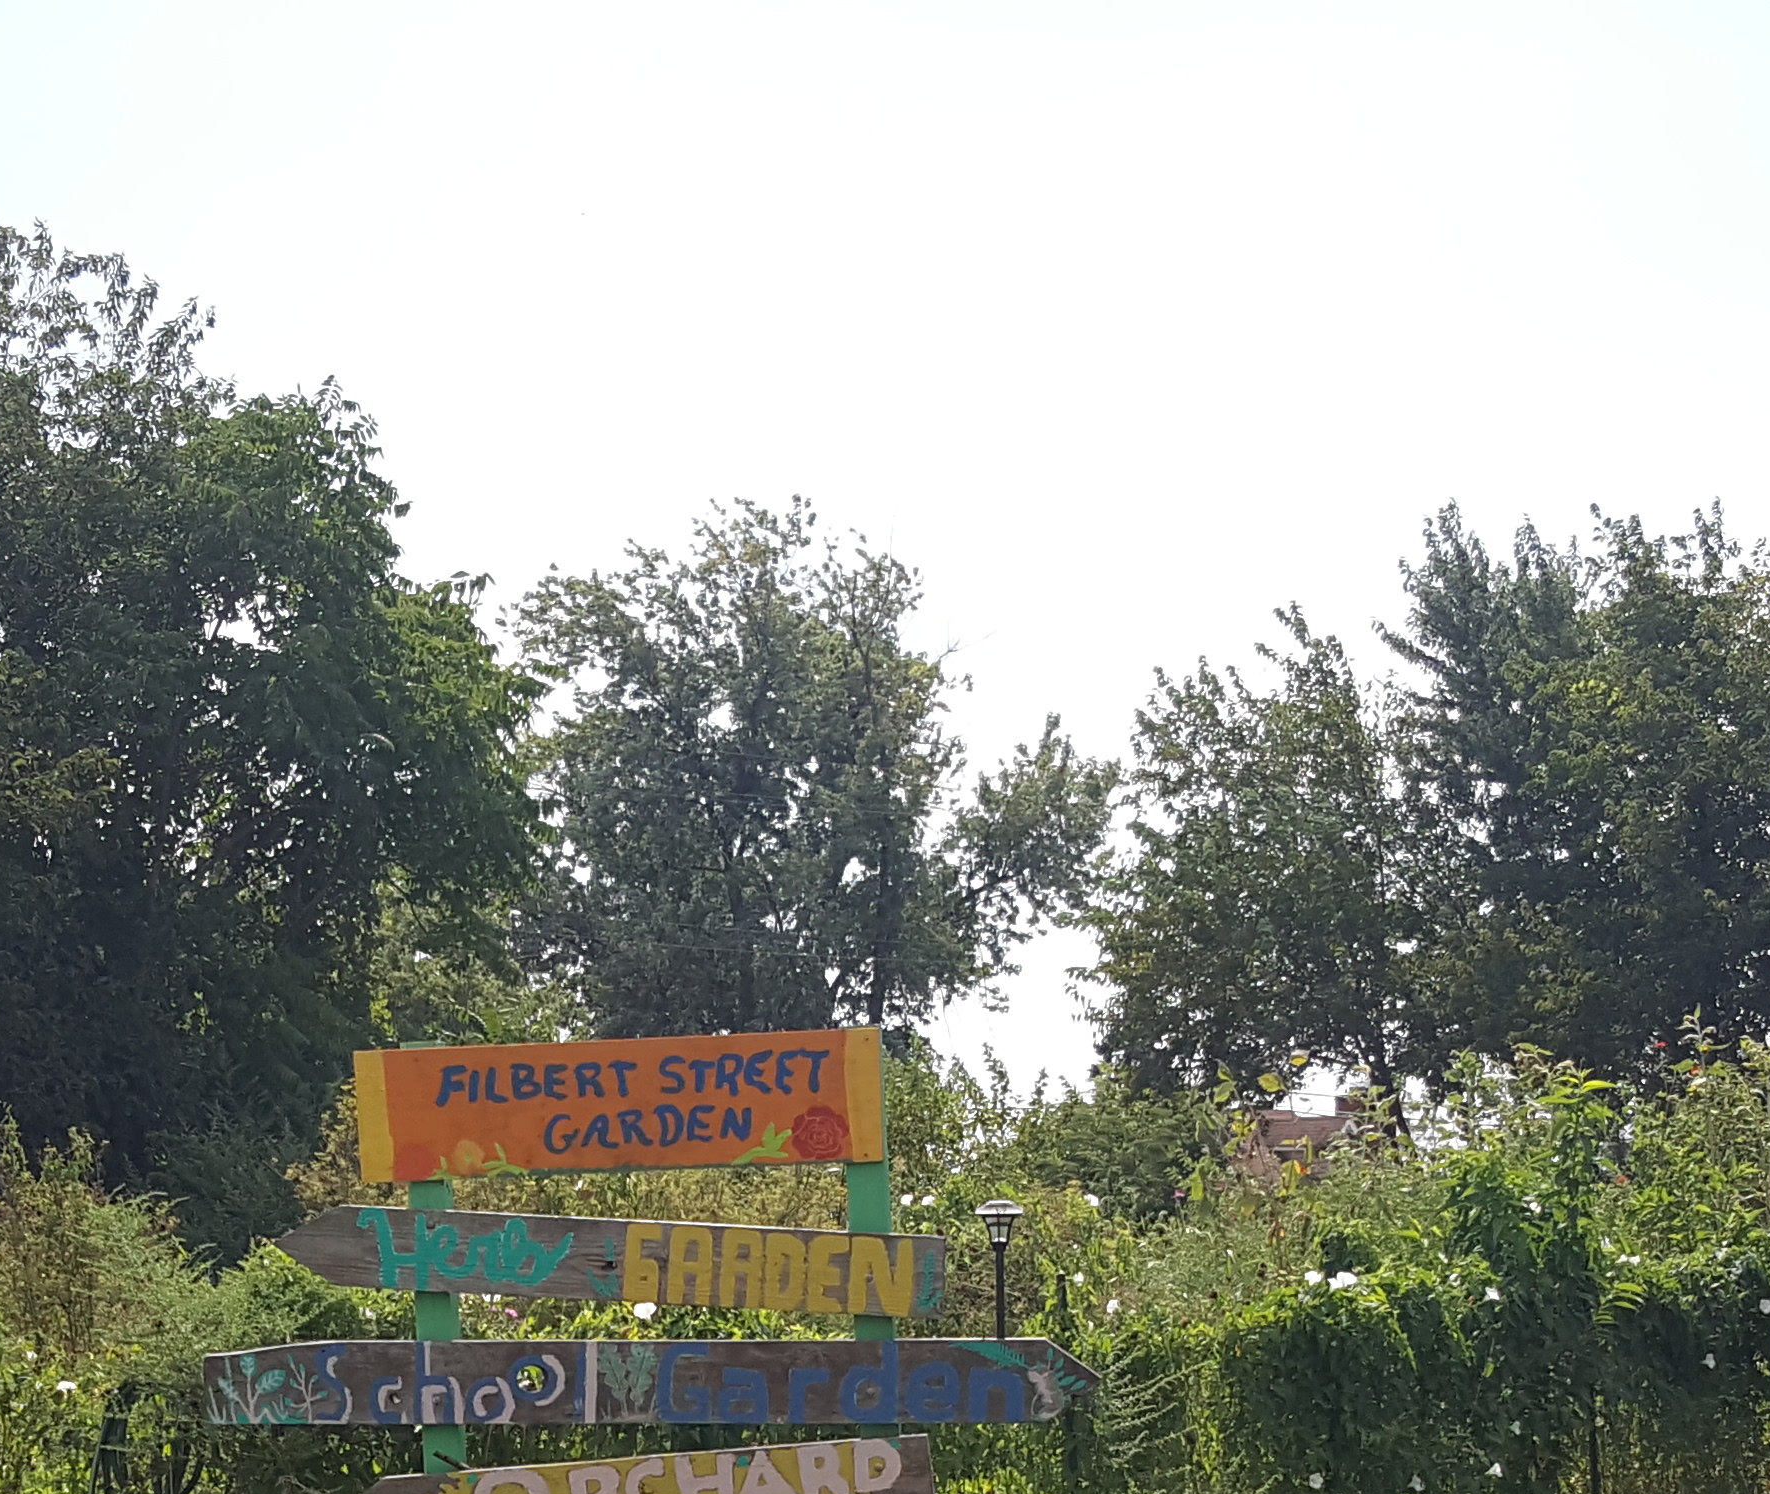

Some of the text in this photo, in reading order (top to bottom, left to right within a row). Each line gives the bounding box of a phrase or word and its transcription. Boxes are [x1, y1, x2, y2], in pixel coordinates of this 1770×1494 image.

[435, 1048, 830, 1106] FILBERT STREET
[543, 1105, 753, 1154] GARDEN
[623, 1224, 914, 1315] GARDEN
[658, 1341, 1028, 1423] Garden
